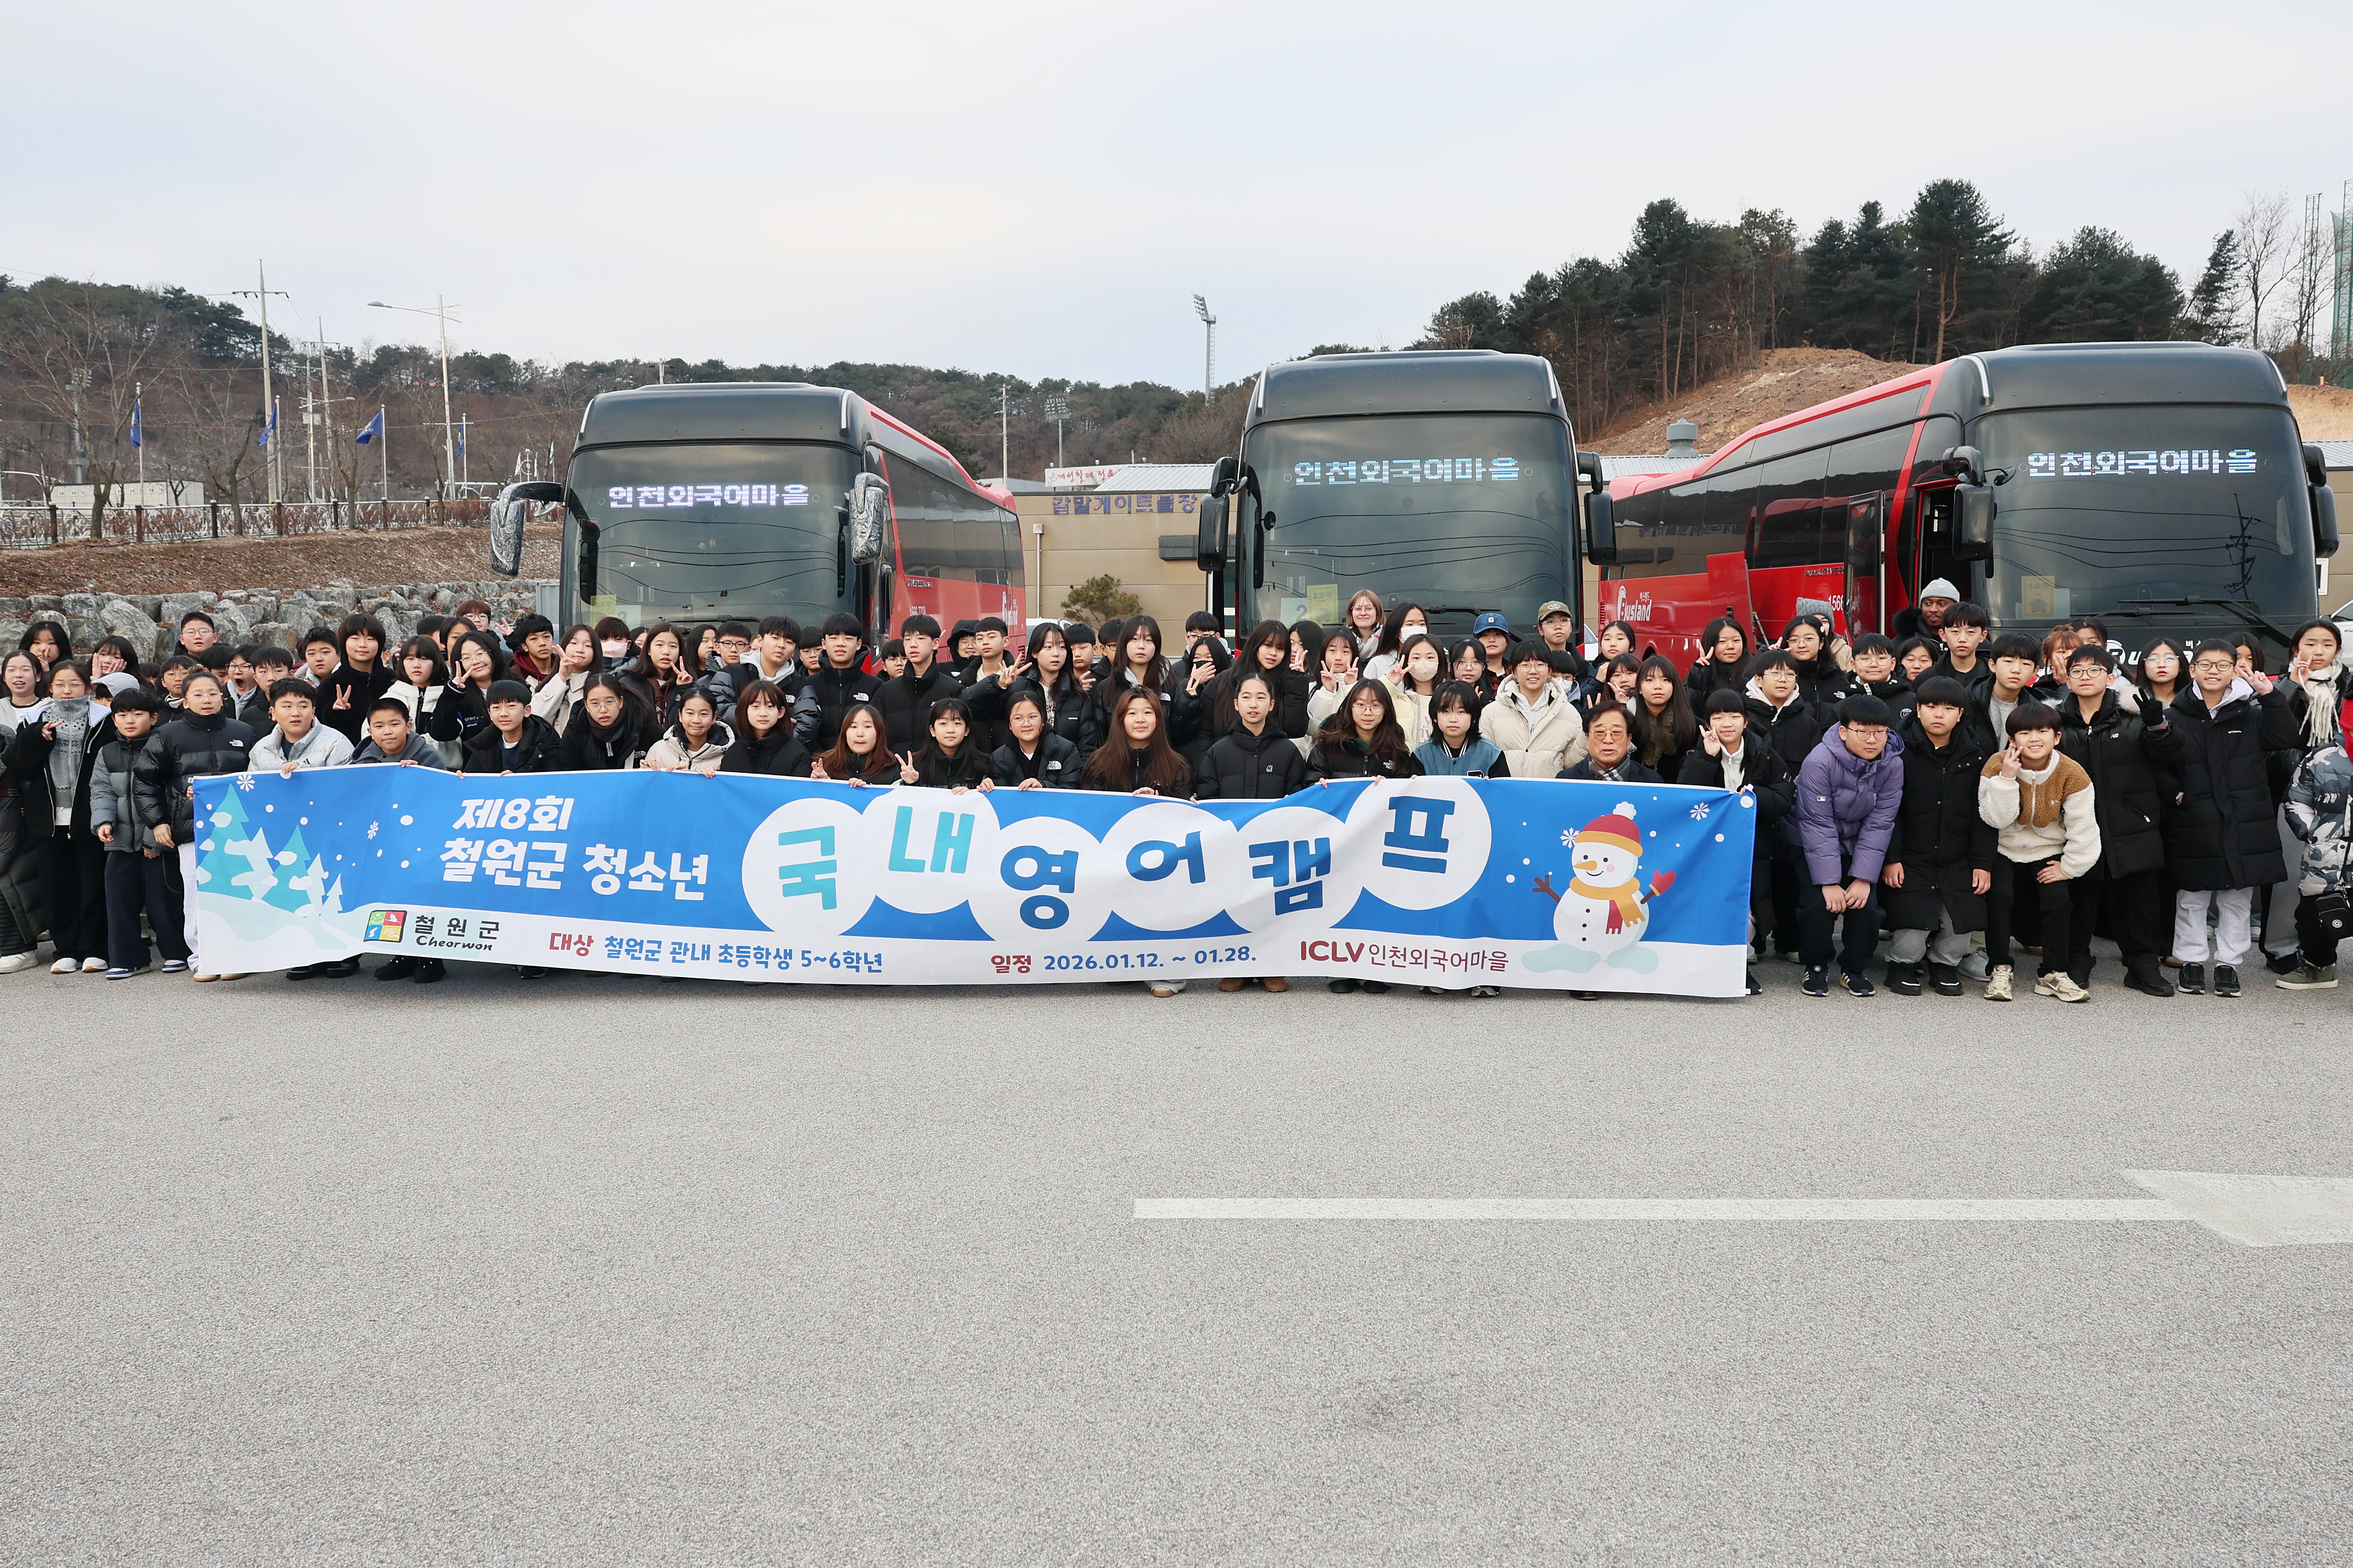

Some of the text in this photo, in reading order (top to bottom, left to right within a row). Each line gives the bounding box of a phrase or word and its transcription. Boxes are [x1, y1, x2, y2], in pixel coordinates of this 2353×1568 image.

[1057, 469, 1094, 483] 개성할매
[1294, 457, 1520, 486] 인천외국어마을
[2028, 449, 2257, 477] 인천외국어마을
[609, 484, 809, 508] 인천외국어마을
[1053, 494, 1197, 515] 갈말게이트볼장
[1296, 604, 1307, 622] 2
[1617, 586, 1652, 622] Busland
[452, 795, 574, 831] 제8회
[440, 837, 708, 901] 철원군 청소년
[416, 936, 493, 951] Cheorwon
[549, 933, 883, 973] 대상 철원군 관내 초등학생 5~6학년
[990, 954, 1031, 974] 일정
[1043, 953, 1164, 970] 2026.01.12.
[1194, 946, 1257, 964] 01.28.
